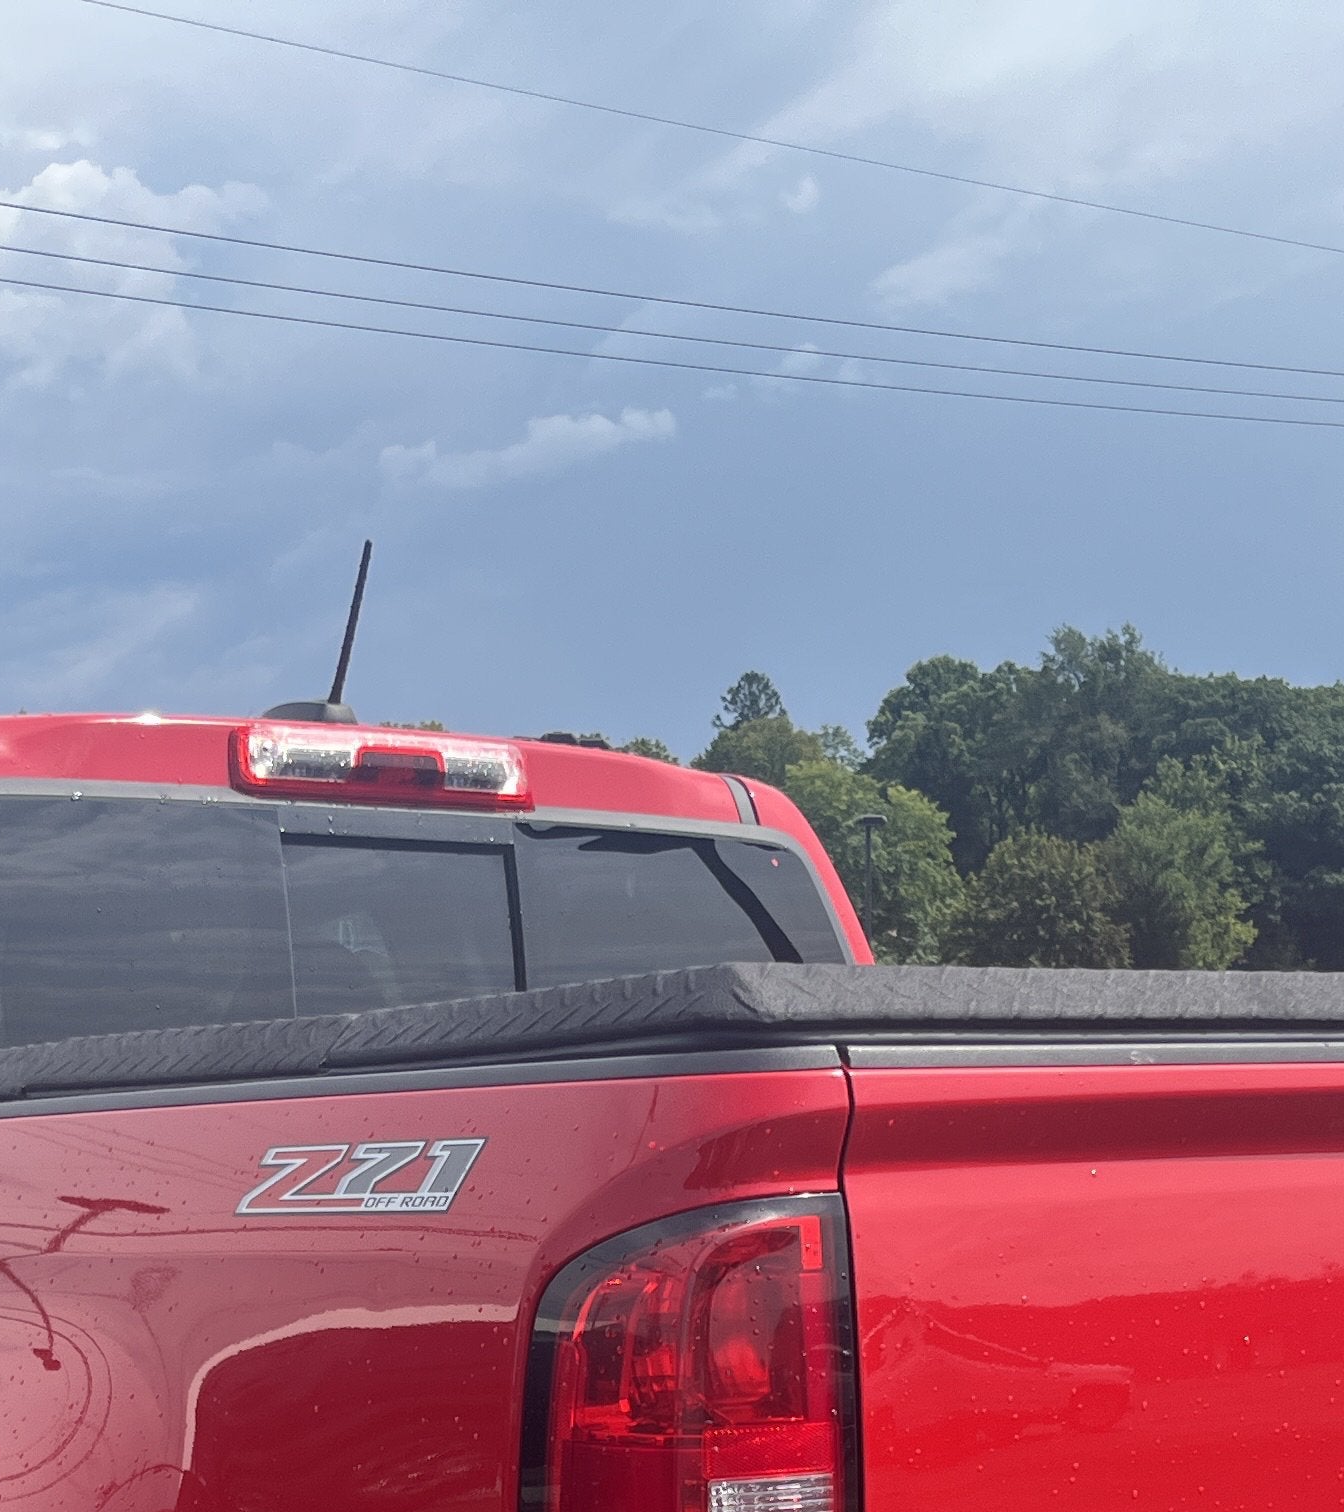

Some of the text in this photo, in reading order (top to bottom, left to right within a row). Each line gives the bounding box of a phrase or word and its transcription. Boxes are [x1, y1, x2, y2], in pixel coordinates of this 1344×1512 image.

[235, 1137, 487, 1215] Z71
[363, 1195, 449, 1209] OFF ROAD
